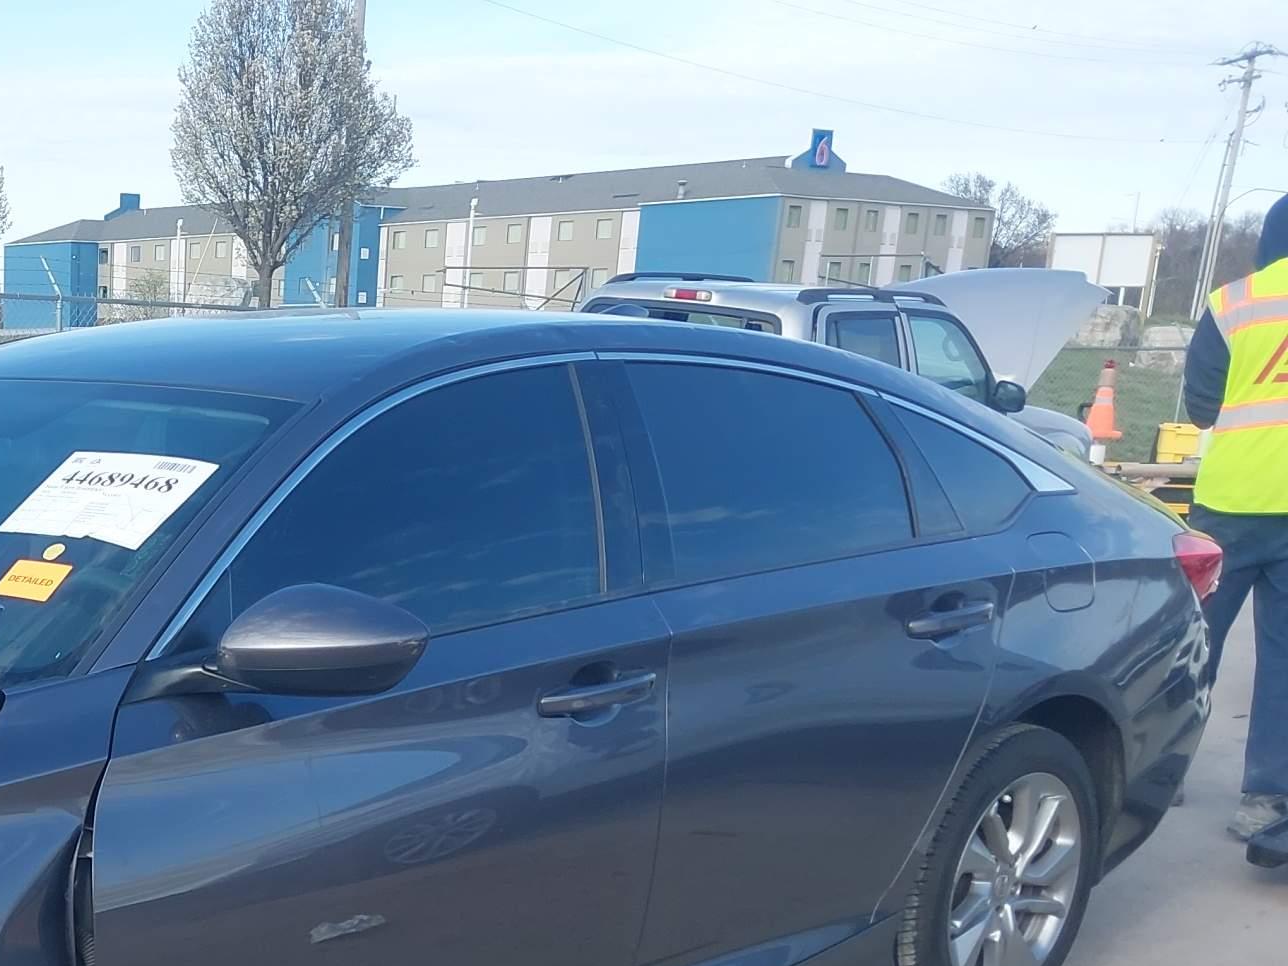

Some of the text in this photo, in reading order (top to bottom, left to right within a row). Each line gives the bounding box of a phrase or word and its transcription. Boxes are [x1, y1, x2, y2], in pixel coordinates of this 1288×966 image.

[815, 136, 830, 167] 6
[62, 470, 179, 493] 44689468
[7, 574, 54, 587] DETAILED
